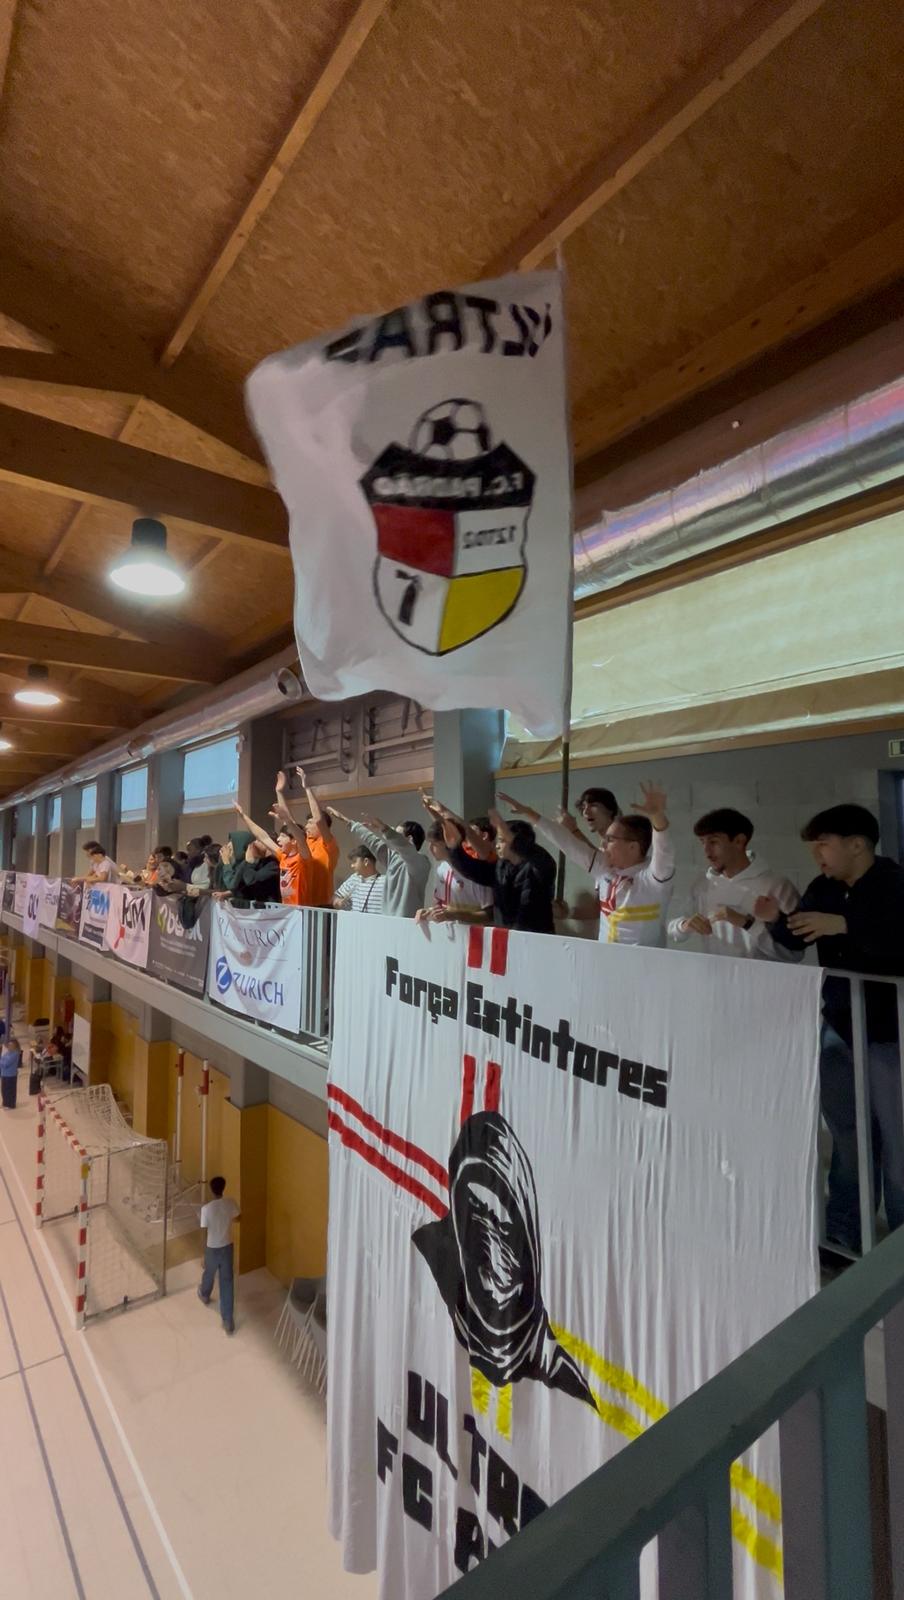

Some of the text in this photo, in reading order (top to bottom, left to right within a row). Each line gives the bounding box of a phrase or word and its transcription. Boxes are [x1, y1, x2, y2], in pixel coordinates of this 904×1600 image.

[232, 972, 284, 1006] ZURICH
[385, 956, 669, 1108] Força Extintores
[377, 1416, 433, 1532] FC
